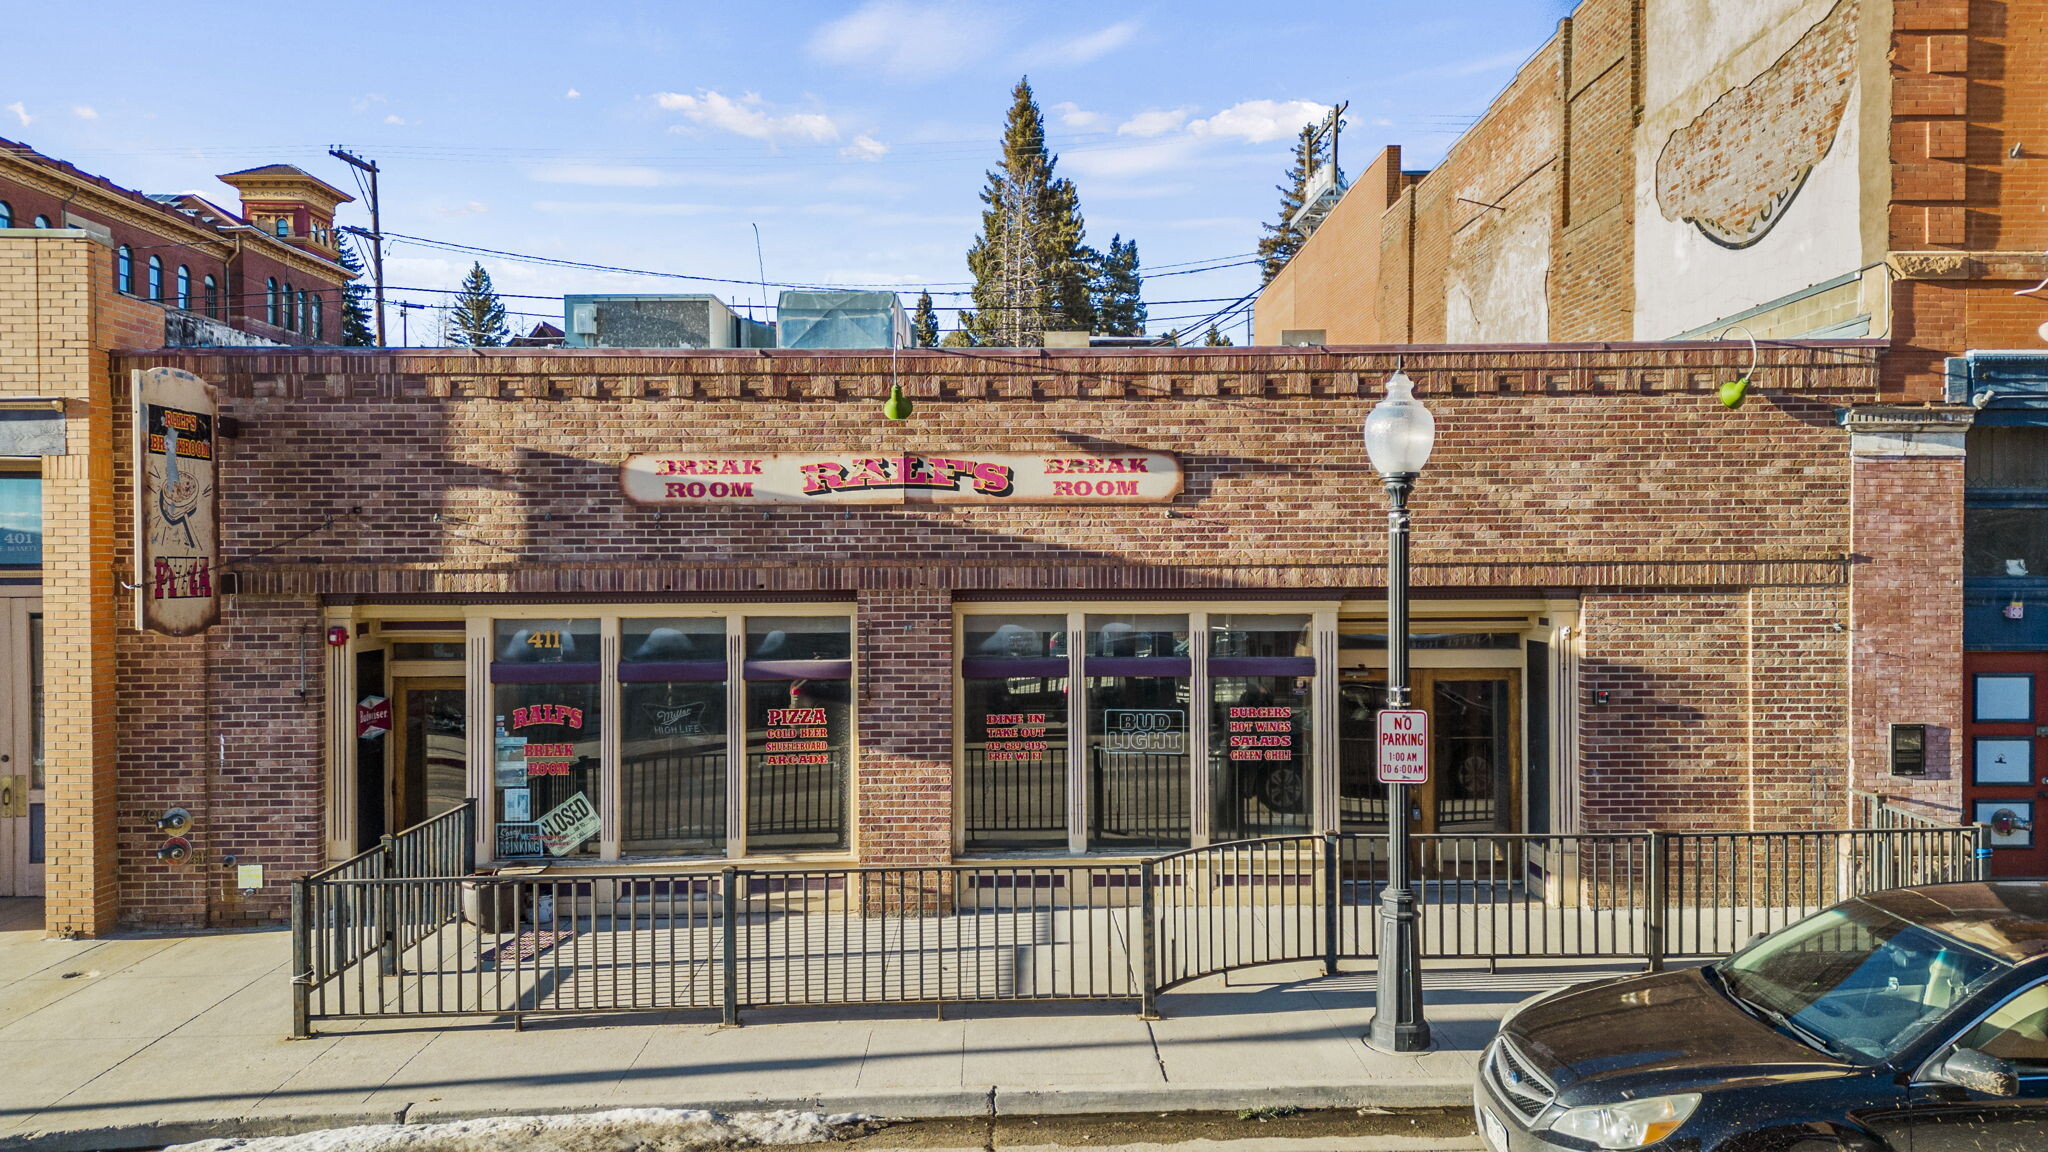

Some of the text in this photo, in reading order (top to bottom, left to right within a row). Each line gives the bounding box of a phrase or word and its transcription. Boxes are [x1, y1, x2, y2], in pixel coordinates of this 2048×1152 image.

[164, 410, 197, 431] RALF'S
[150, 434, 210, 458] BRKROOM
[656, 459, 763, 475] BREAK
[1043, 458, 1148, 474] BREAK
[800, 457, 1013, 497] RALF'S
[665, 482, 753, 498] ROOM
[1053, 481, 1139, 496] ROOM
[4, 533, 32, 544] 401
[527, 631, 560, 648] 411
[512, 704, 583, 729] RALF'S
[656, 709, 692, 722] Miller
[767, 708, 827, 726] PIZZA
[1230, 706, 1291, 718] BURGERS
[986, 714, 1046, 724] DINE IN
[1120, 713, 1171, 731] BUD
[1394, 717, 1412, 730] NO
[654, 724, 700, 734] HIGH LIFE
[987, 727, 1046, 738] TAKE OUT
[1230, 721, 1291, 732] HOT WINGS
[767, 728, 828, 739] COLD BEER
[1382, 733, 1423, 746] PARKING
[766, 741, 828, 752] SHUFFLEBOARD
[985, 741, 1048, 750] 719 689 9195
[1230, 735, 1292, 746] SALADS
[524, 743, 574, 757] BREAK
[988, 751, 1013, 761] FREE
[1230, 749, 1291, 760] GREEN CHILI
[767, 754, 828, 765] ARCADE
[1389, 752, 1417, 762] 1:00 AM
[528, 761, 569, 776] ROOM
[1383, 764, 1391, 773] TO
[542, 798, 590, 836] CLOSED
